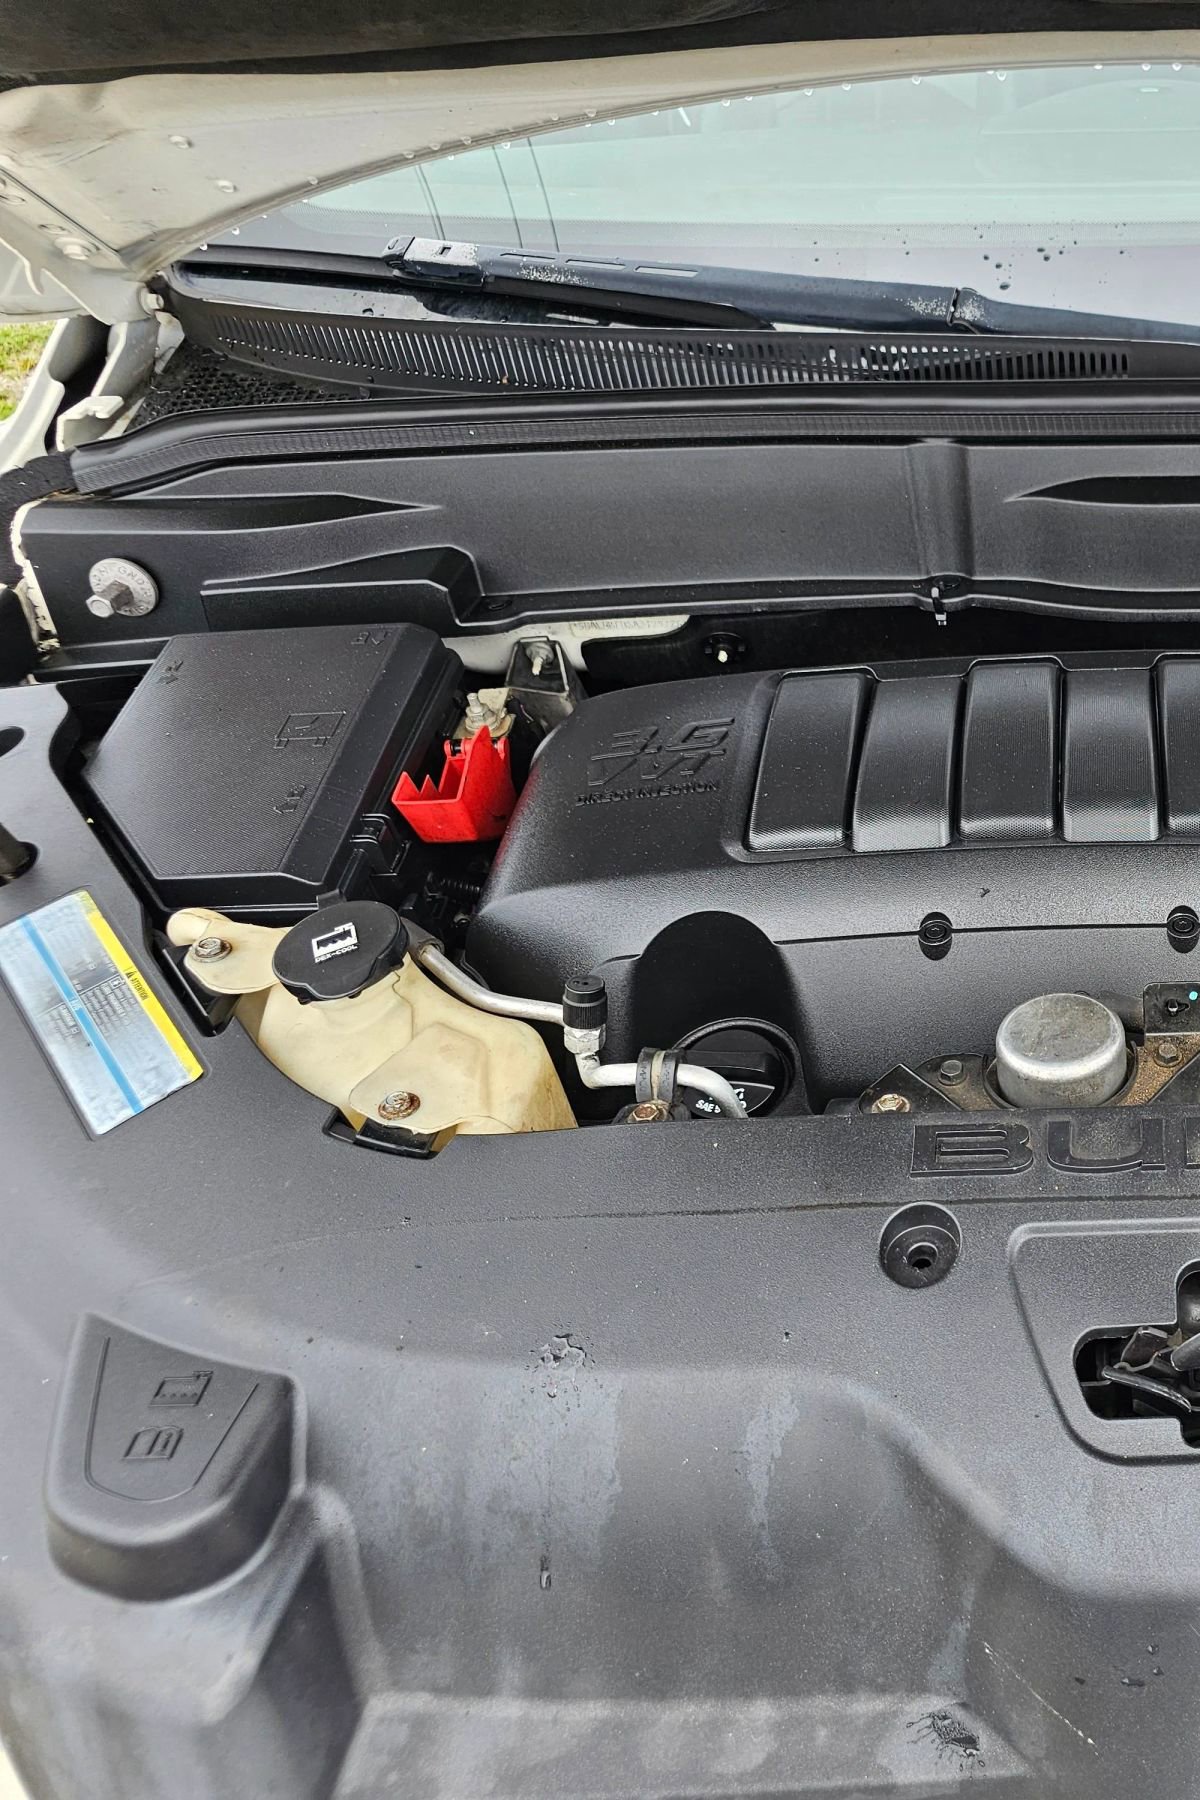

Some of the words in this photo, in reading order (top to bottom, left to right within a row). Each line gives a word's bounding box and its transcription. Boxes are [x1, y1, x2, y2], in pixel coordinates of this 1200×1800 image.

[575, 787, 635, 807] DIRECT
[635, 779, 720, 799] INJECTION
[130, 977, 148, 1001] ATTENTION
[695, 1099, 715, 1113] SAE
